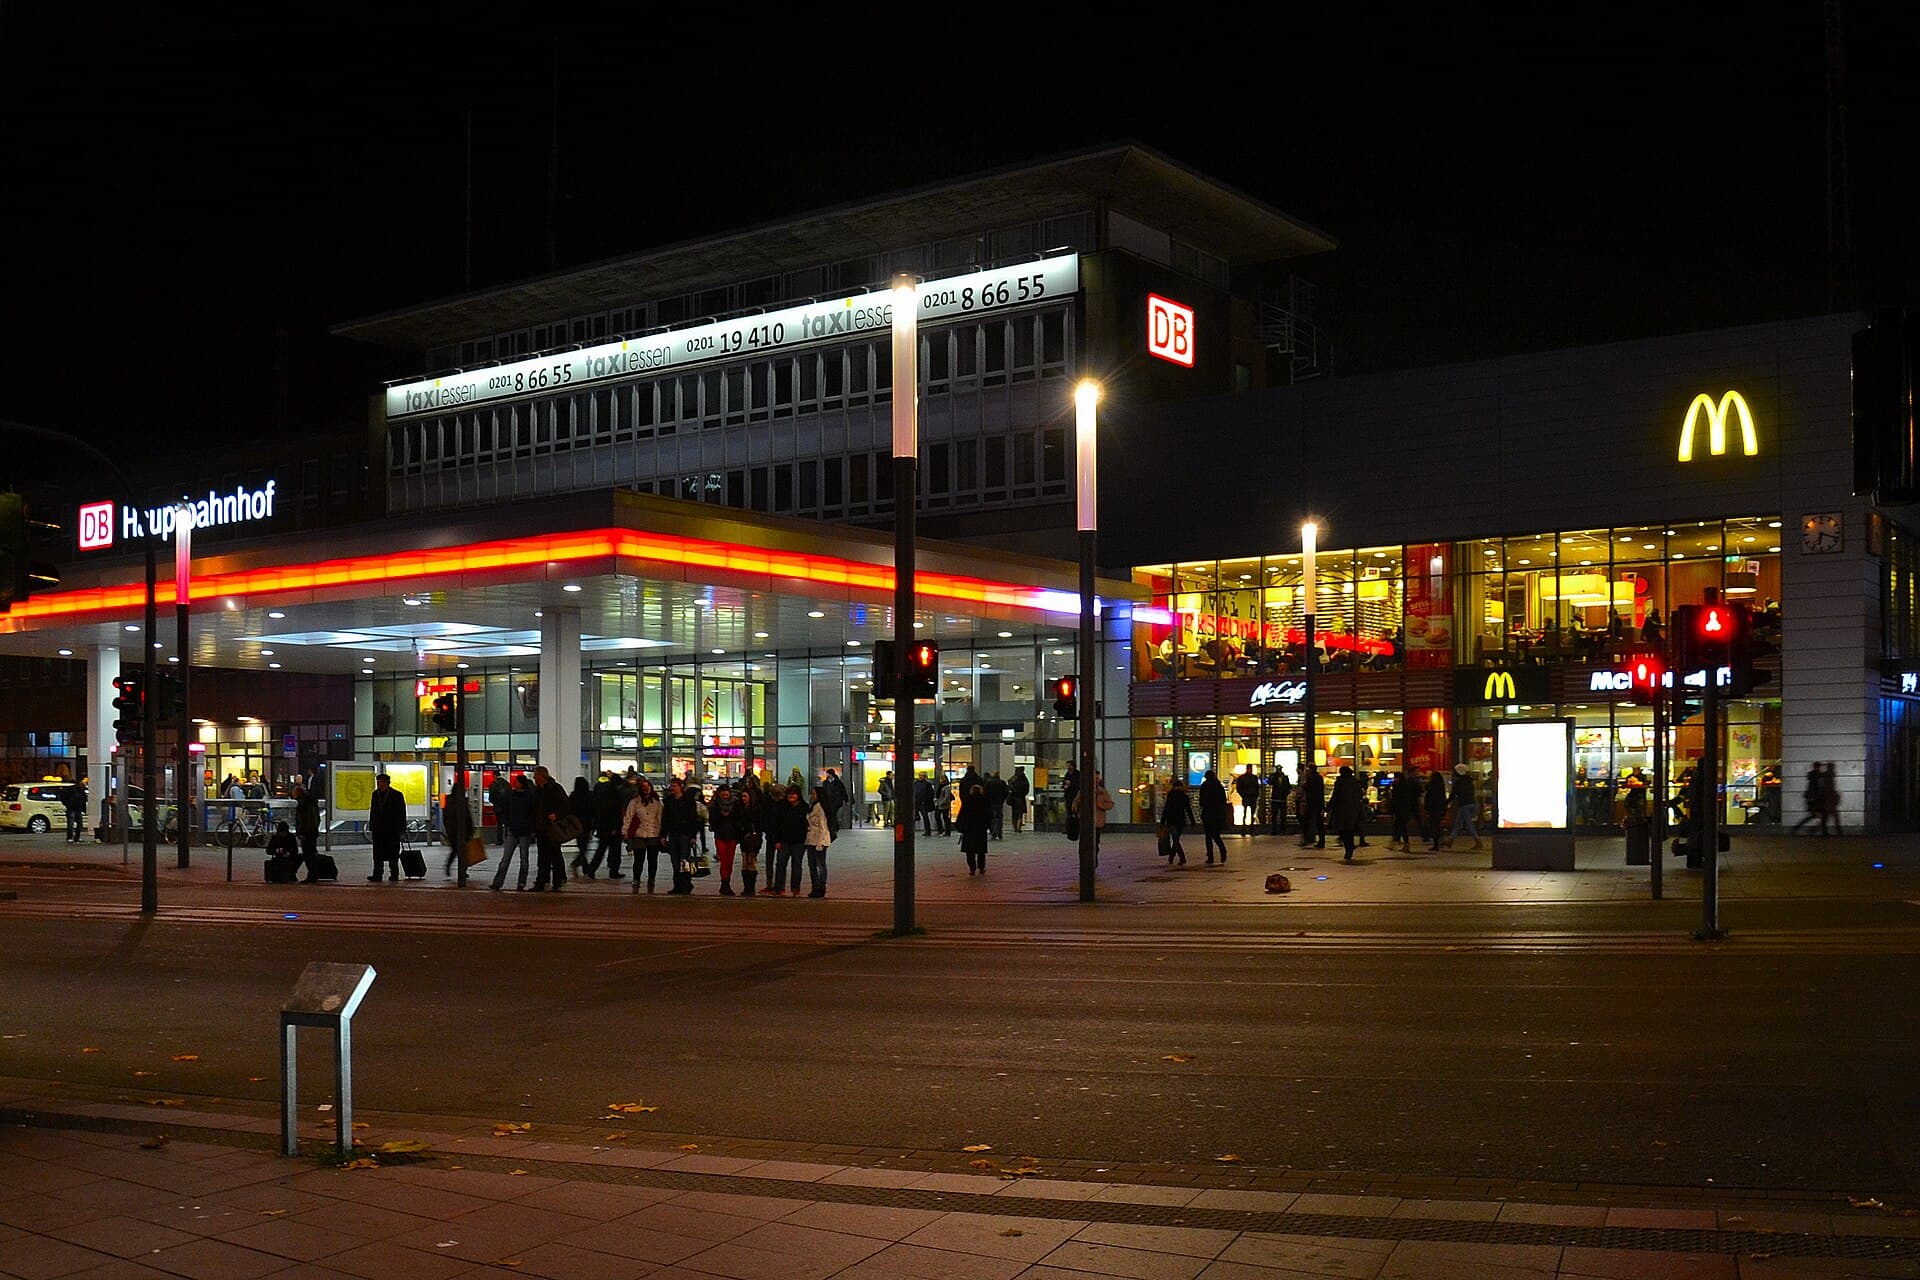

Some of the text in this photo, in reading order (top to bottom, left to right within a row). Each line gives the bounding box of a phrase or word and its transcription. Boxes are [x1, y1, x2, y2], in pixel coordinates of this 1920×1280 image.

[489, 374, 513, 390] 0201
[515, 372, 525, 391] 8
[528, 367, 548, 389] 66
[553, 363, 573, 386] 55
[686, 334, 715, 353] 0201
[719, 326, 743, 354] 19
[747, 322, 785, 349] 410
[802, 298, 895, 337] taxiesse
[923, 289, 958, 309] 0201
[961, 286, 975, 311] 8
[981, 279, 1010, 306] 66
[1017, 273, 1046, 302] 55
[1153, 304, 1189, 356] DB
[84, 509, 110, 542] DB
